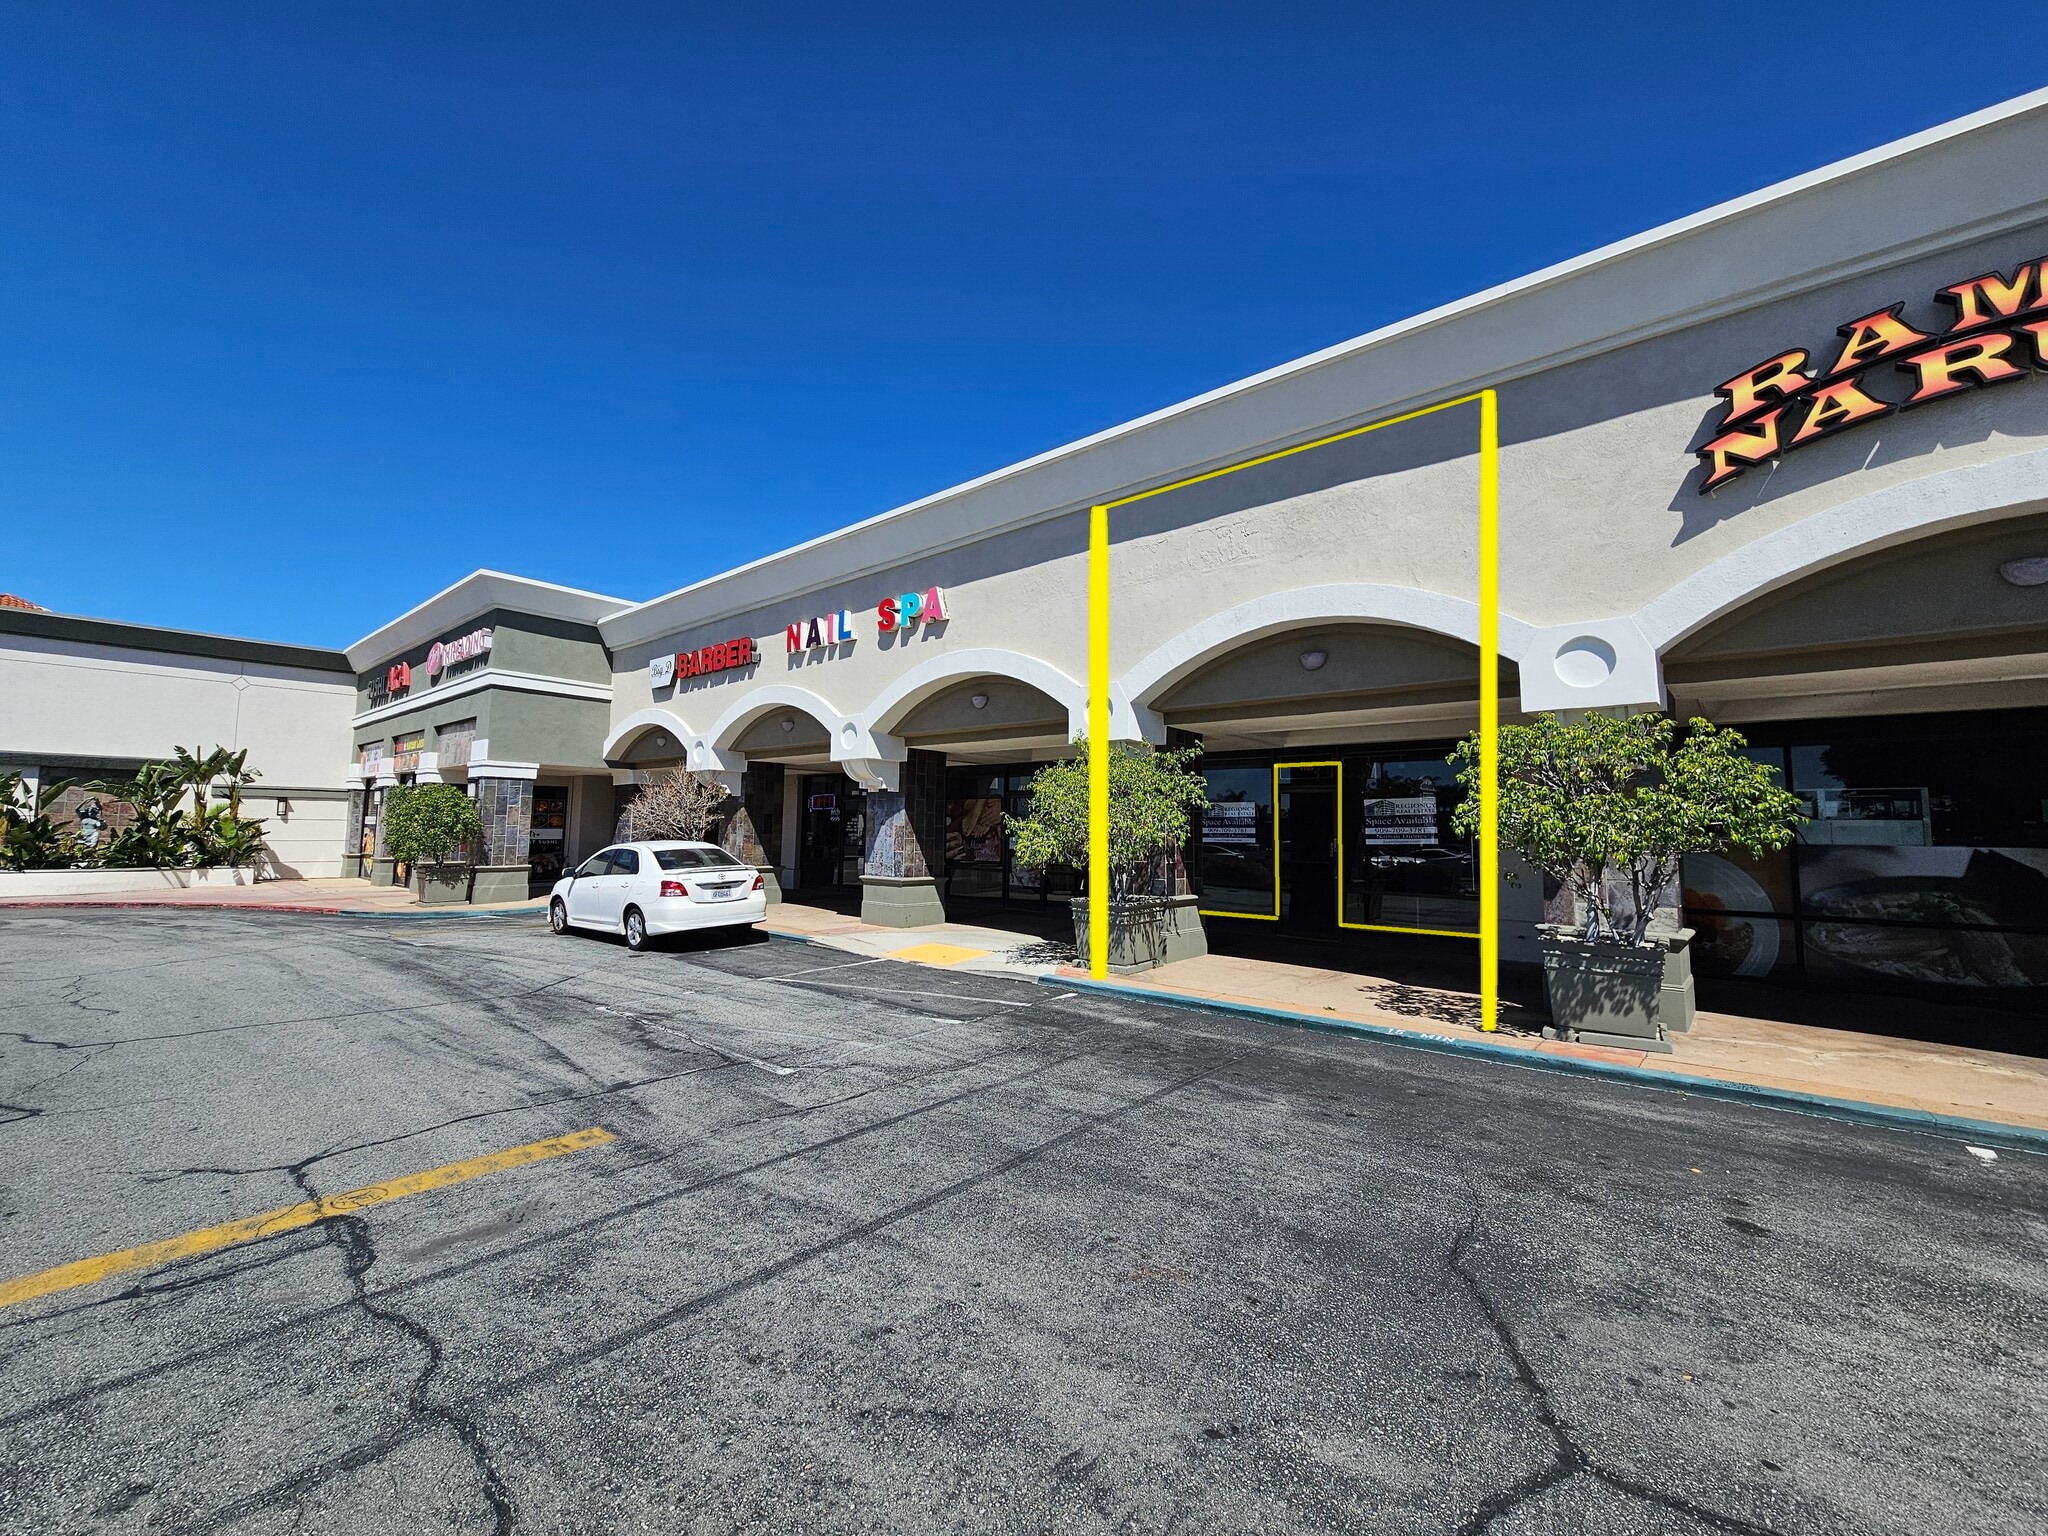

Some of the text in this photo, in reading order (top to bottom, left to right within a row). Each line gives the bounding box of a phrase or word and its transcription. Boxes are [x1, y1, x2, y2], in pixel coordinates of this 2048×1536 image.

[787, 586, 945, 653] NAIL SPA
[676, 636, 754, 680] BARBER
[651, 660, 673, 679] Big D
[1201, 817, 1256, 827] Space Available
[1365, 816, 1437, 827] Space Available
[1420, 1033, 1456, 1043] MIN
